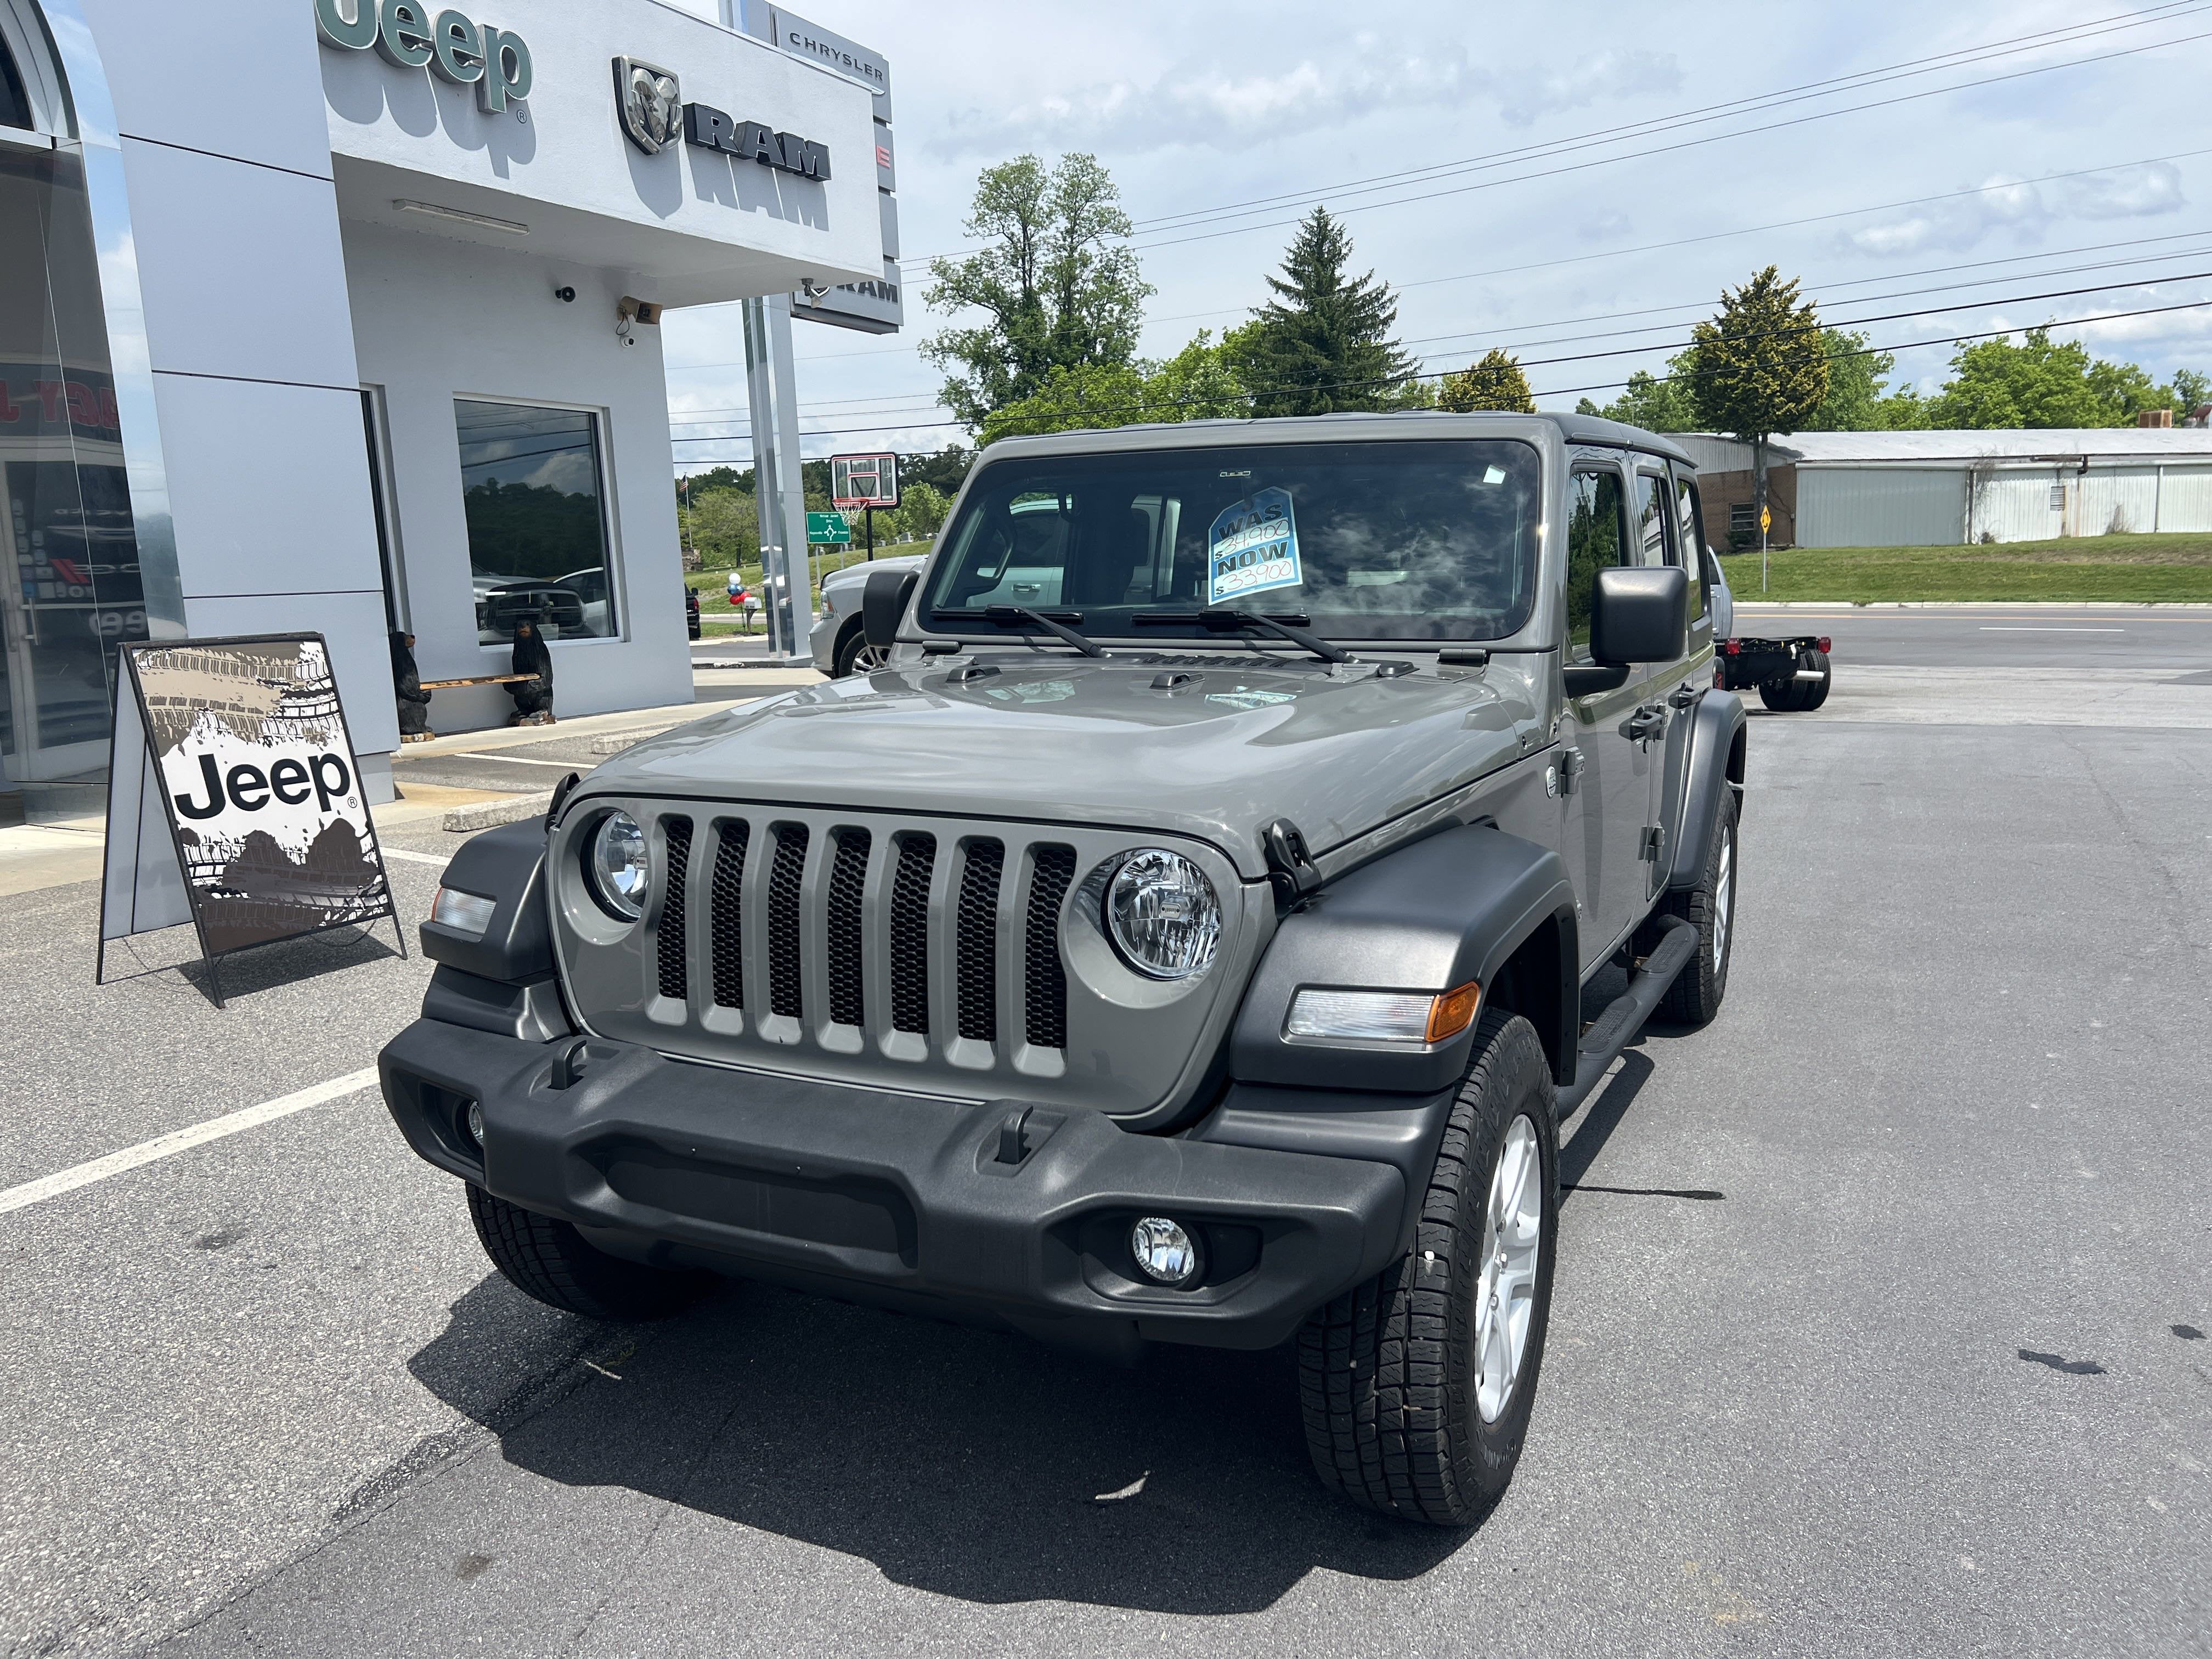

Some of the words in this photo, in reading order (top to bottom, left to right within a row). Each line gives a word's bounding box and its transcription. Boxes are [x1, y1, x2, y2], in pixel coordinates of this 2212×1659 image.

[789, 32, 883, 81] CHRYSLER
[682, 103, 832, 182] RAM
[1218, 504, 1283, 540] WAS
[1217, 541, 1289, 577] NOW
[174, 752, 351, 820] Jeep
